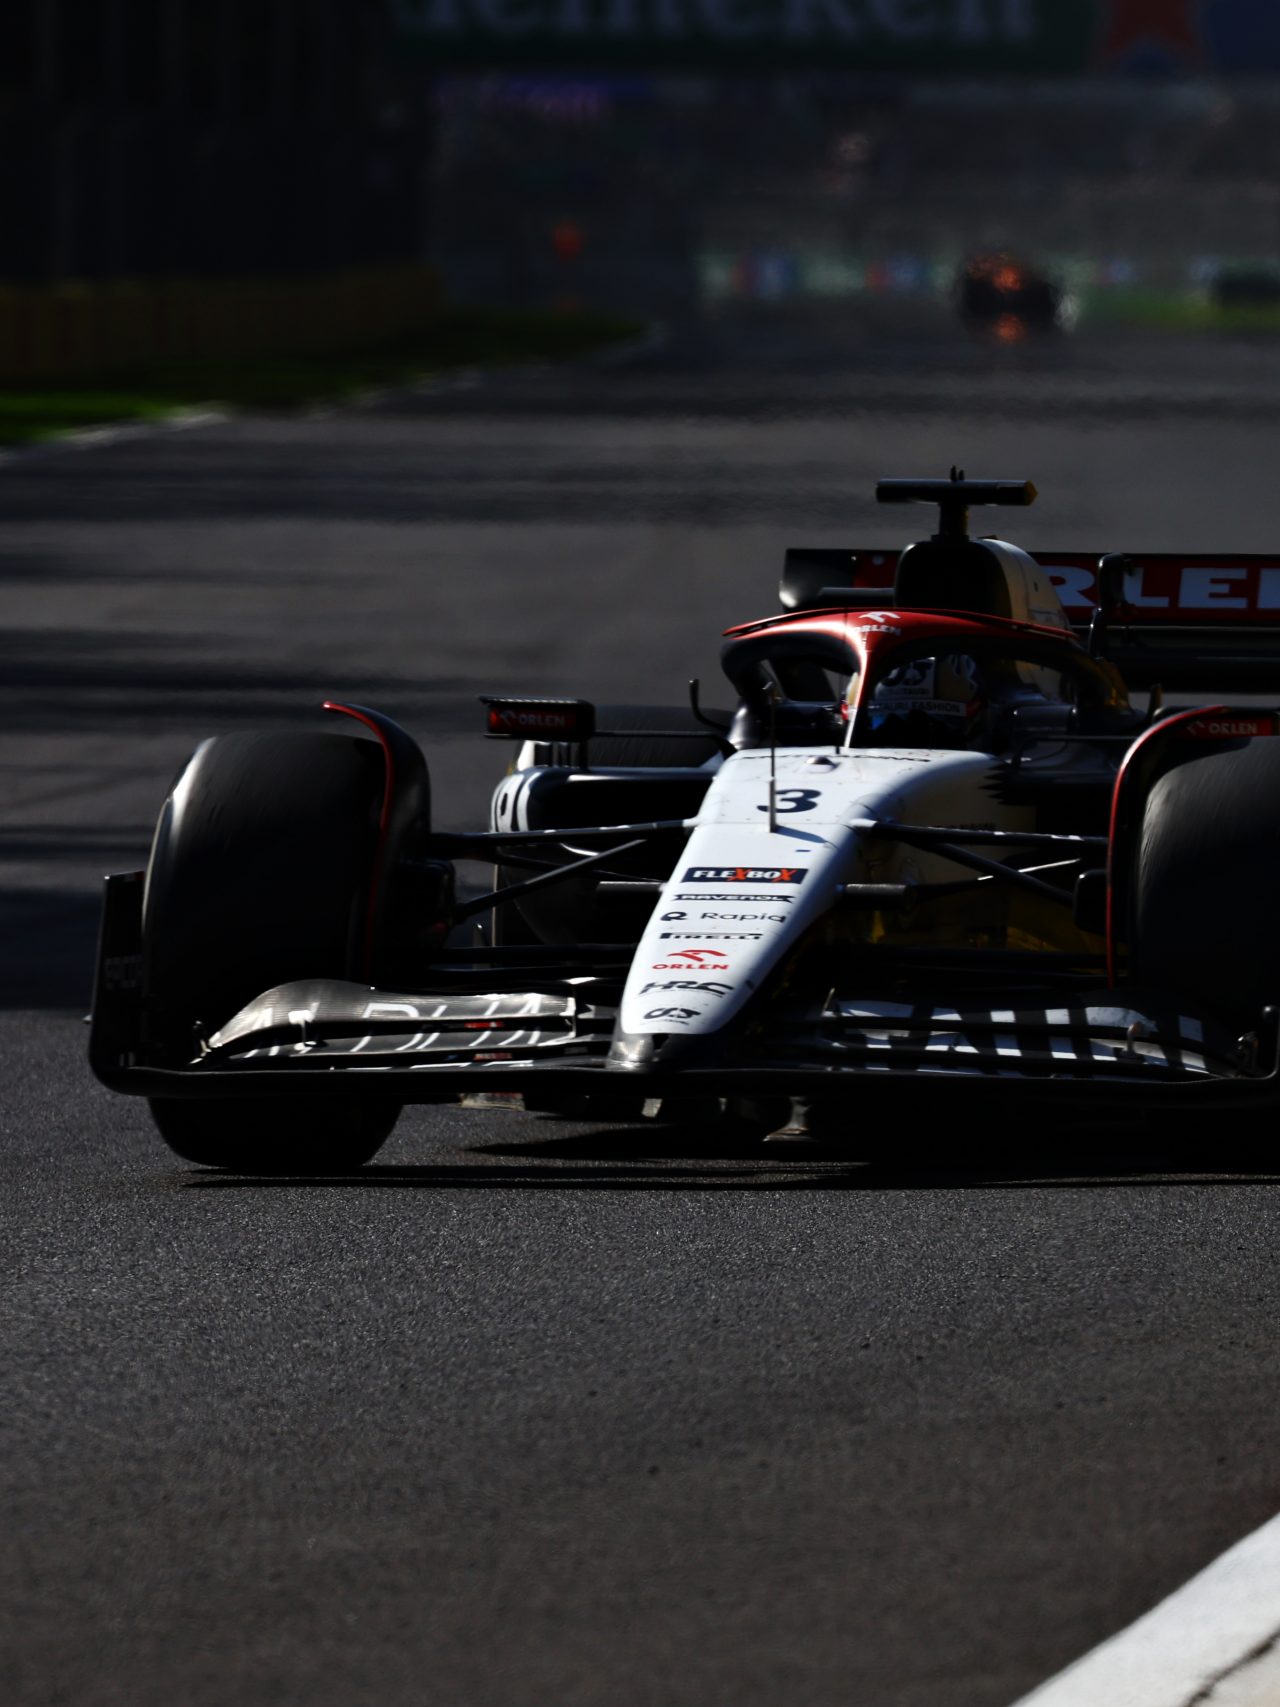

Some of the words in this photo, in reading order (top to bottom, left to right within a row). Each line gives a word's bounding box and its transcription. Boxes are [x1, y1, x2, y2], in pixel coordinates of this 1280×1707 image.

[518, 712, 566, 728] ORLEN
[1207, 721, 1259, 735] ORLEN
[757, 789, 822, 813] 3
[692, 868, 798, 882] FLEXBOX
[680, 894, 787, 902] RAVENOL
[660, 932, 764, 940] PIRELLI
[652, 963, 729, 971] ORLEN
